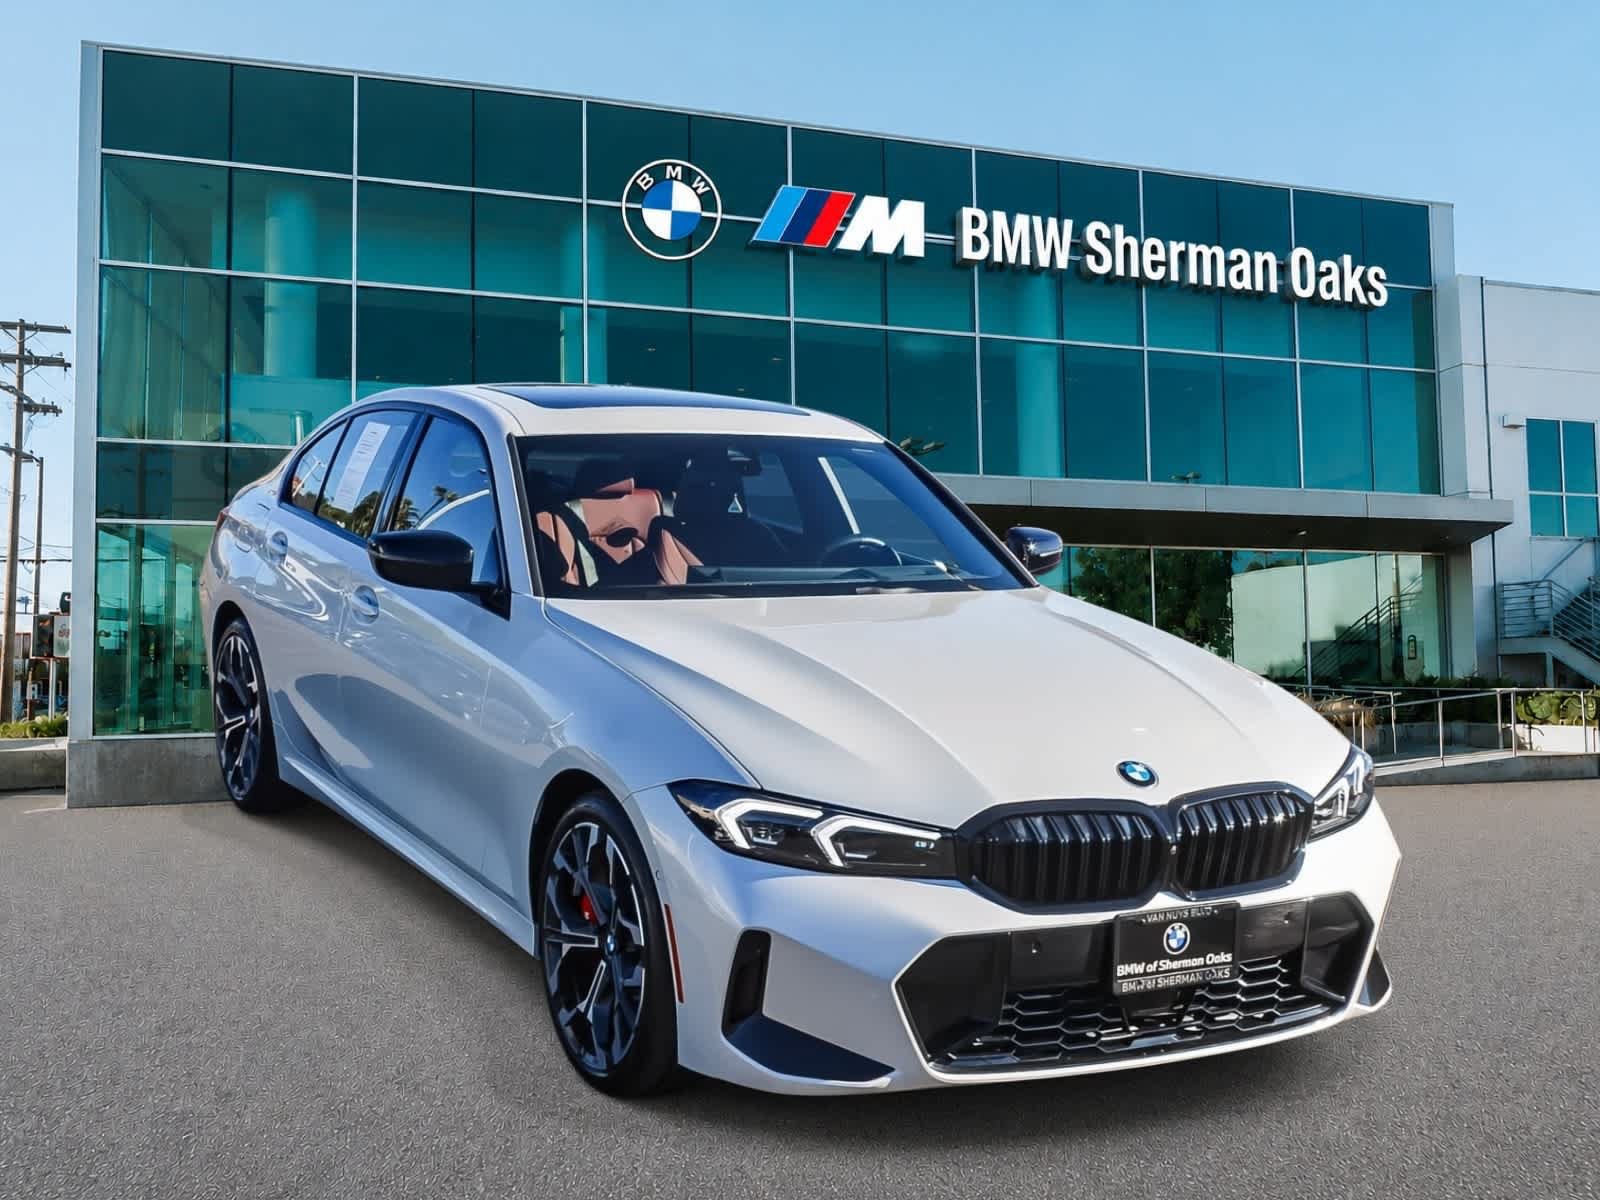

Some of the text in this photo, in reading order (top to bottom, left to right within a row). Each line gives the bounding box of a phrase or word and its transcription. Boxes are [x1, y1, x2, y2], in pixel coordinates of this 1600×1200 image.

[636, 165, 711, 196] BMW
[837, 195, 925, 257] M
[959, 206, 1388, 308] BMW Sherman Oaks
[1146, 910, 1165, 922] VAN
[1166, 909, 1189, 921] NUYS
[1116, 952, 1232, 977] BMW of Sherman Oaks
[1121, 979, 1145, 993] BMW
[1157, 972, 1202, 988] SHERMAN
[1205, 967, 1231, 981] OAKS
